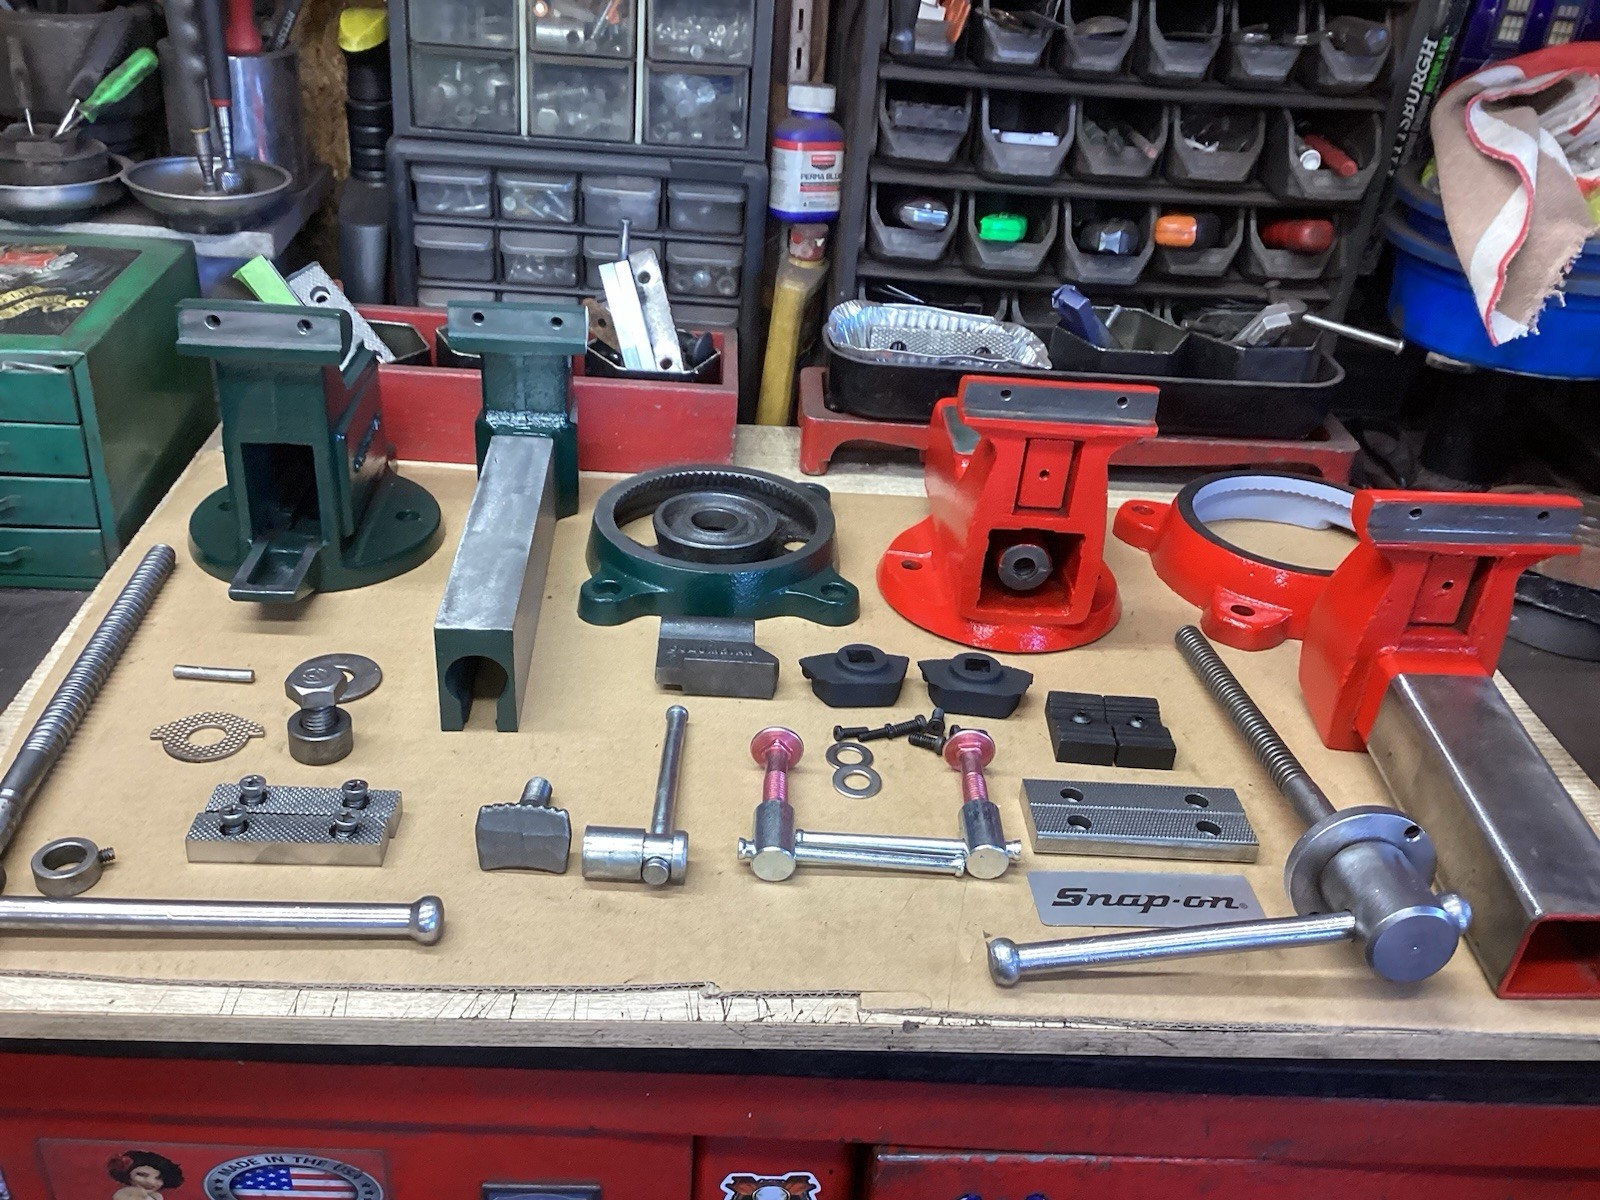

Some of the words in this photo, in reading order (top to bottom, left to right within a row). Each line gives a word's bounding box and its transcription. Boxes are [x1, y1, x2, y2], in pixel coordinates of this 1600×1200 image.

[800, 172, 826, 181] PERMA
[1051, 887, 1240, 914] Snap-on
[217, 1158, 261, 1176] MADE
[265, 1155, 285, 1164] IN
[293, 1156, 328, 1167] THE
